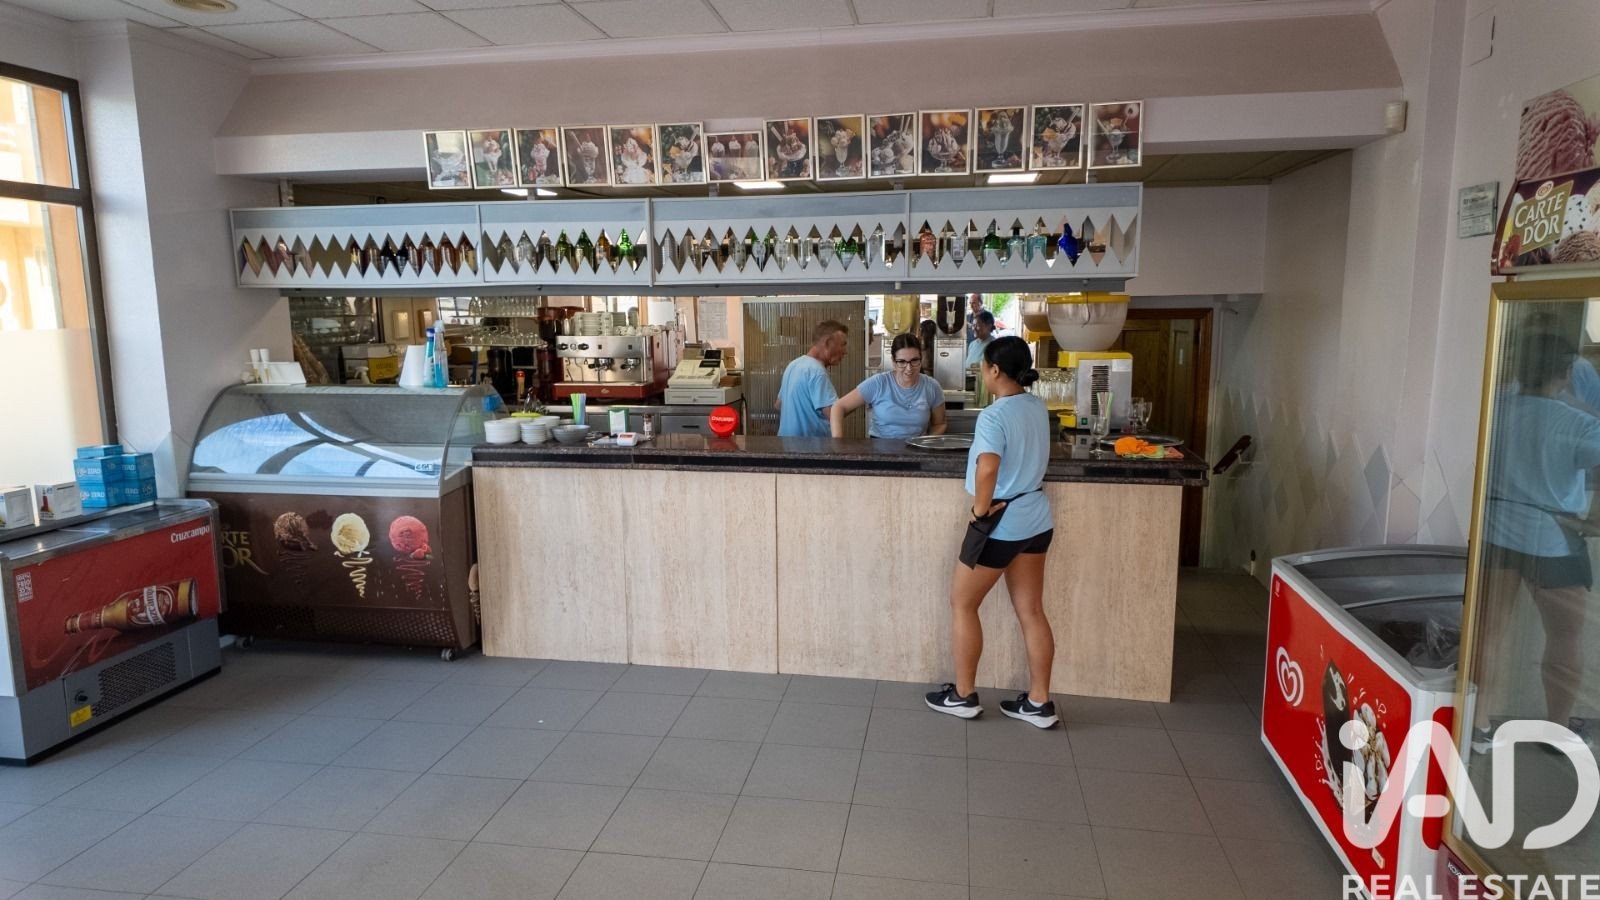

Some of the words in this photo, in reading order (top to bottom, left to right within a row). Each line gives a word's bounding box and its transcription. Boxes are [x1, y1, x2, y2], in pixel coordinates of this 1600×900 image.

[1515, 192, 1565, 228] CARTE
[1523, 215, 1560, 246] D'OR
[170, 524, 211, 544] Cruzcampo
[220, 531, 251, 548] RTE
